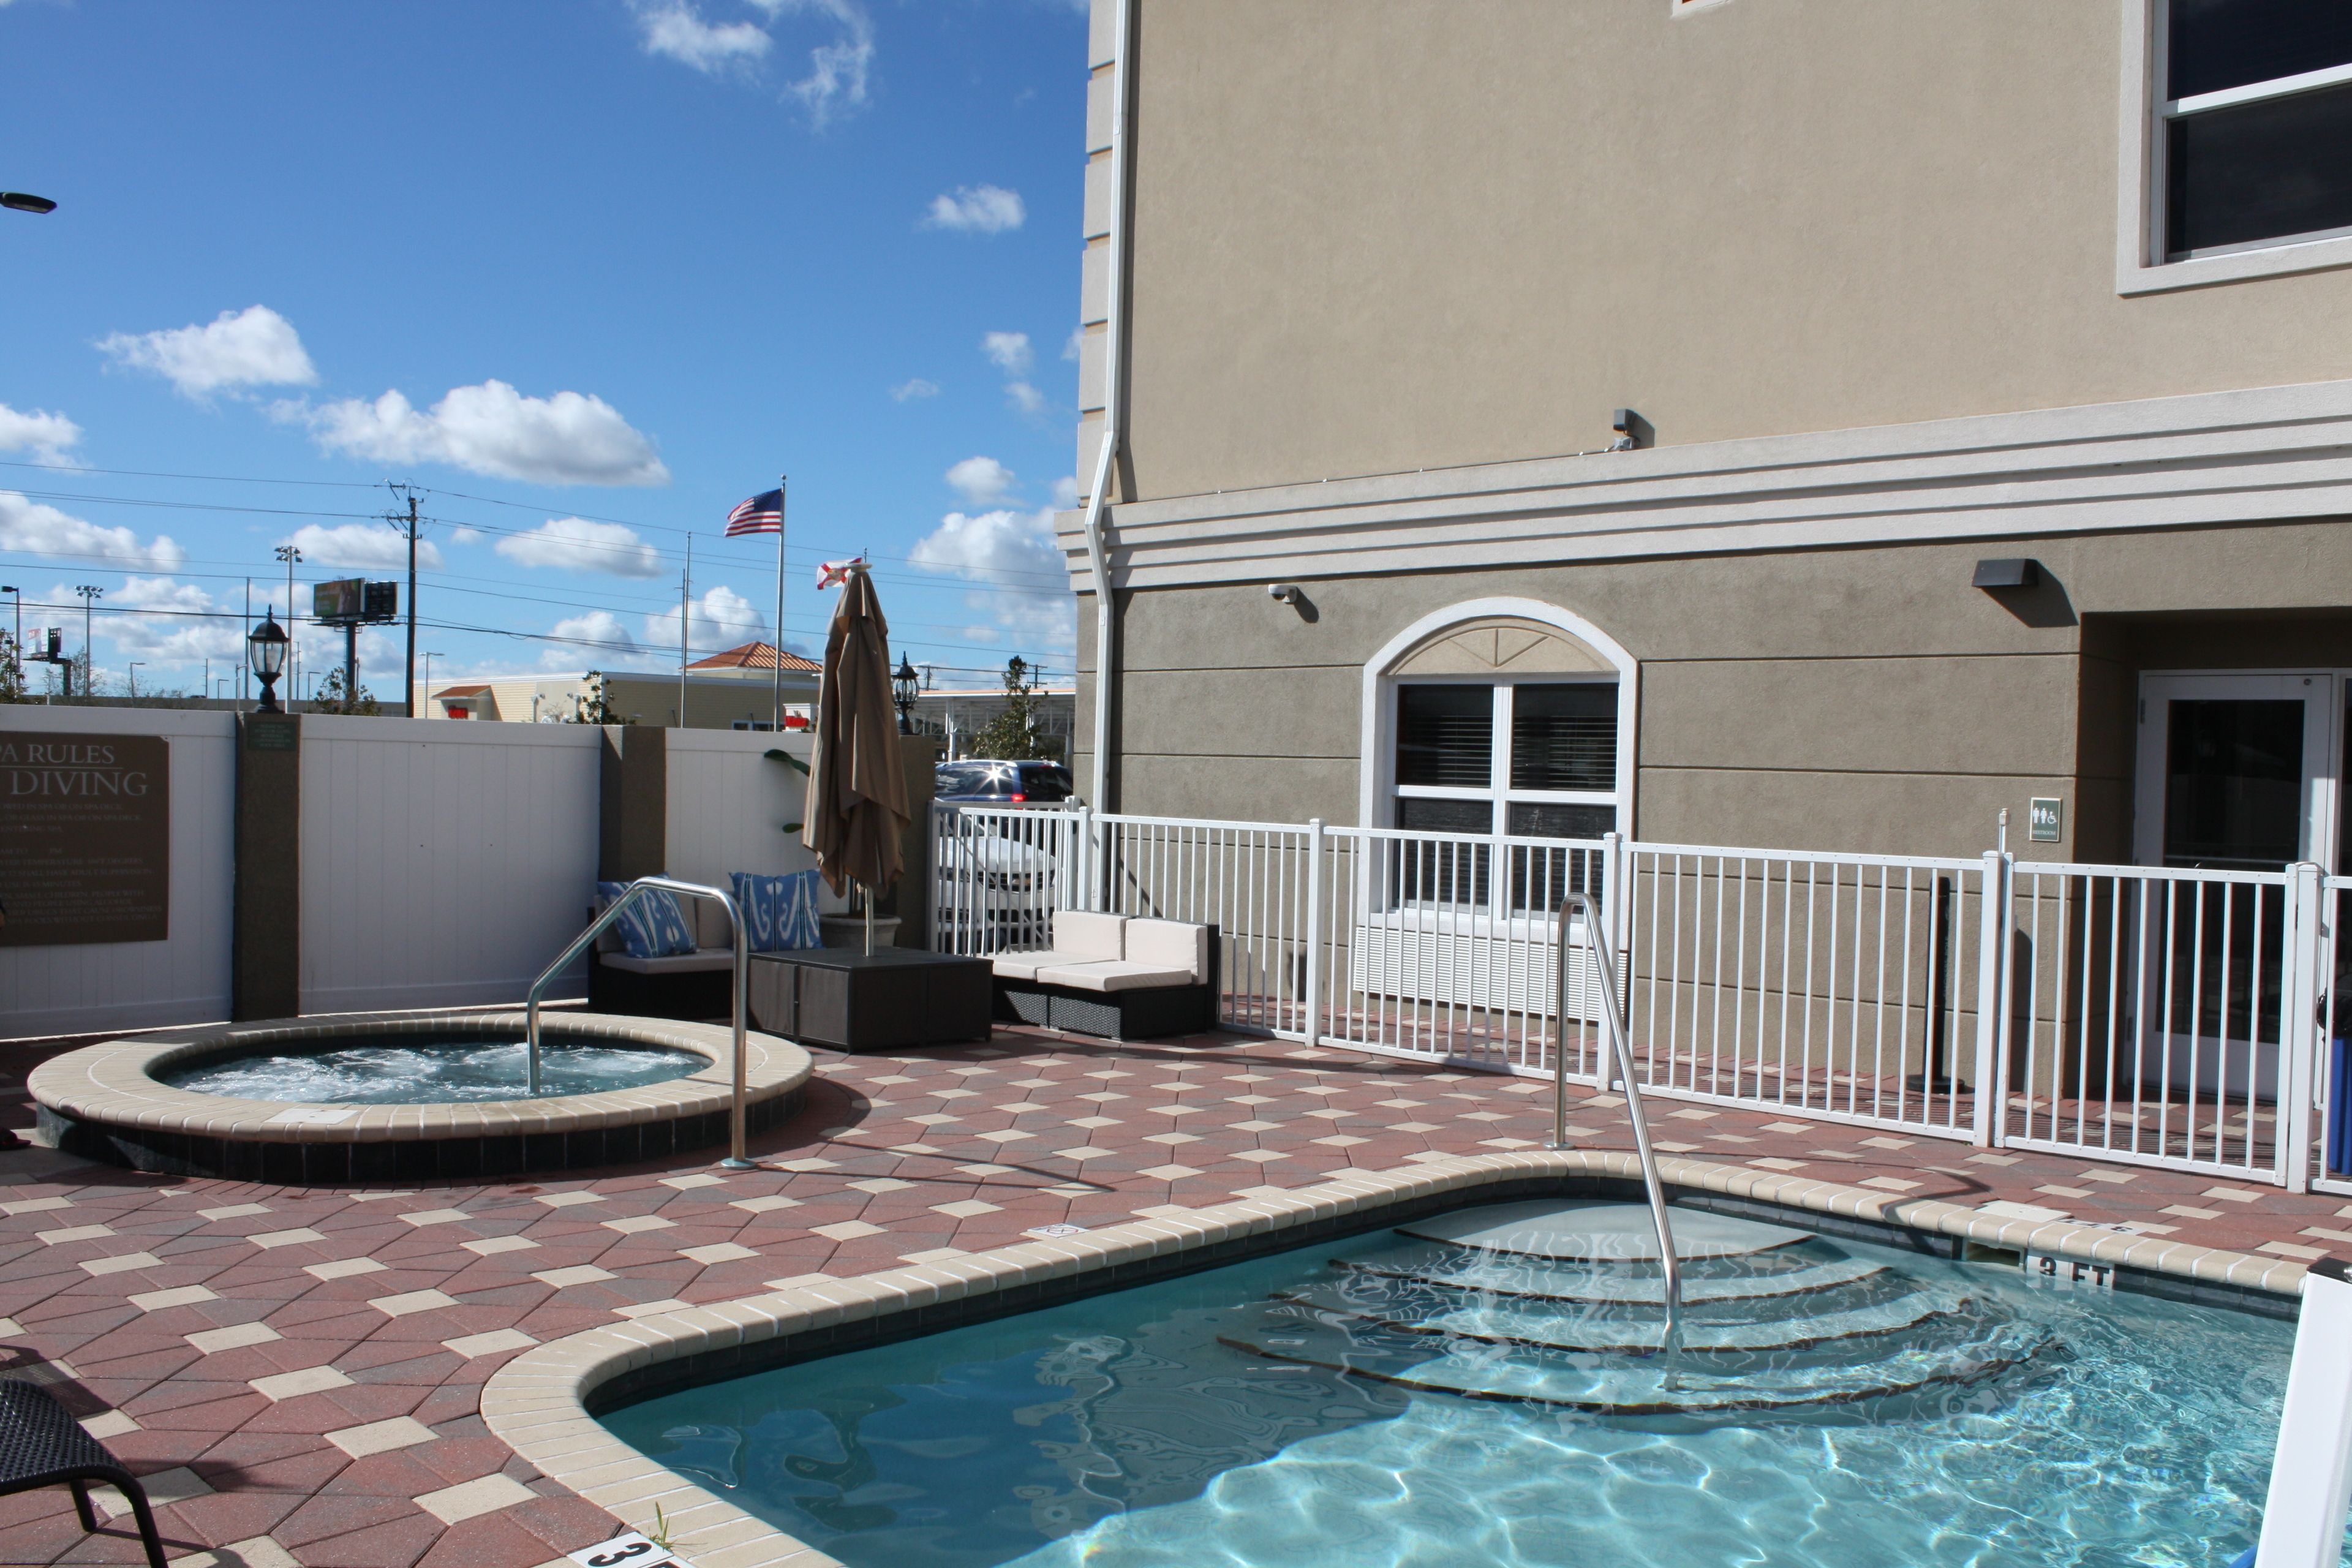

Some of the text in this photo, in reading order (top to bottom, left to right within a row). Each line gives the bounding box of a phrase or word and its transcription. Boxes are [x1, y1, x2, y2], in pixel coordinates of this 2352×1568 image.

[0, 743, 115, 764] A RULES
[10, 771, 148, 796] DIVING
[2039, 1256, 2110, 1286] 3 FT
[587, 1542, 652, 1567] 3
